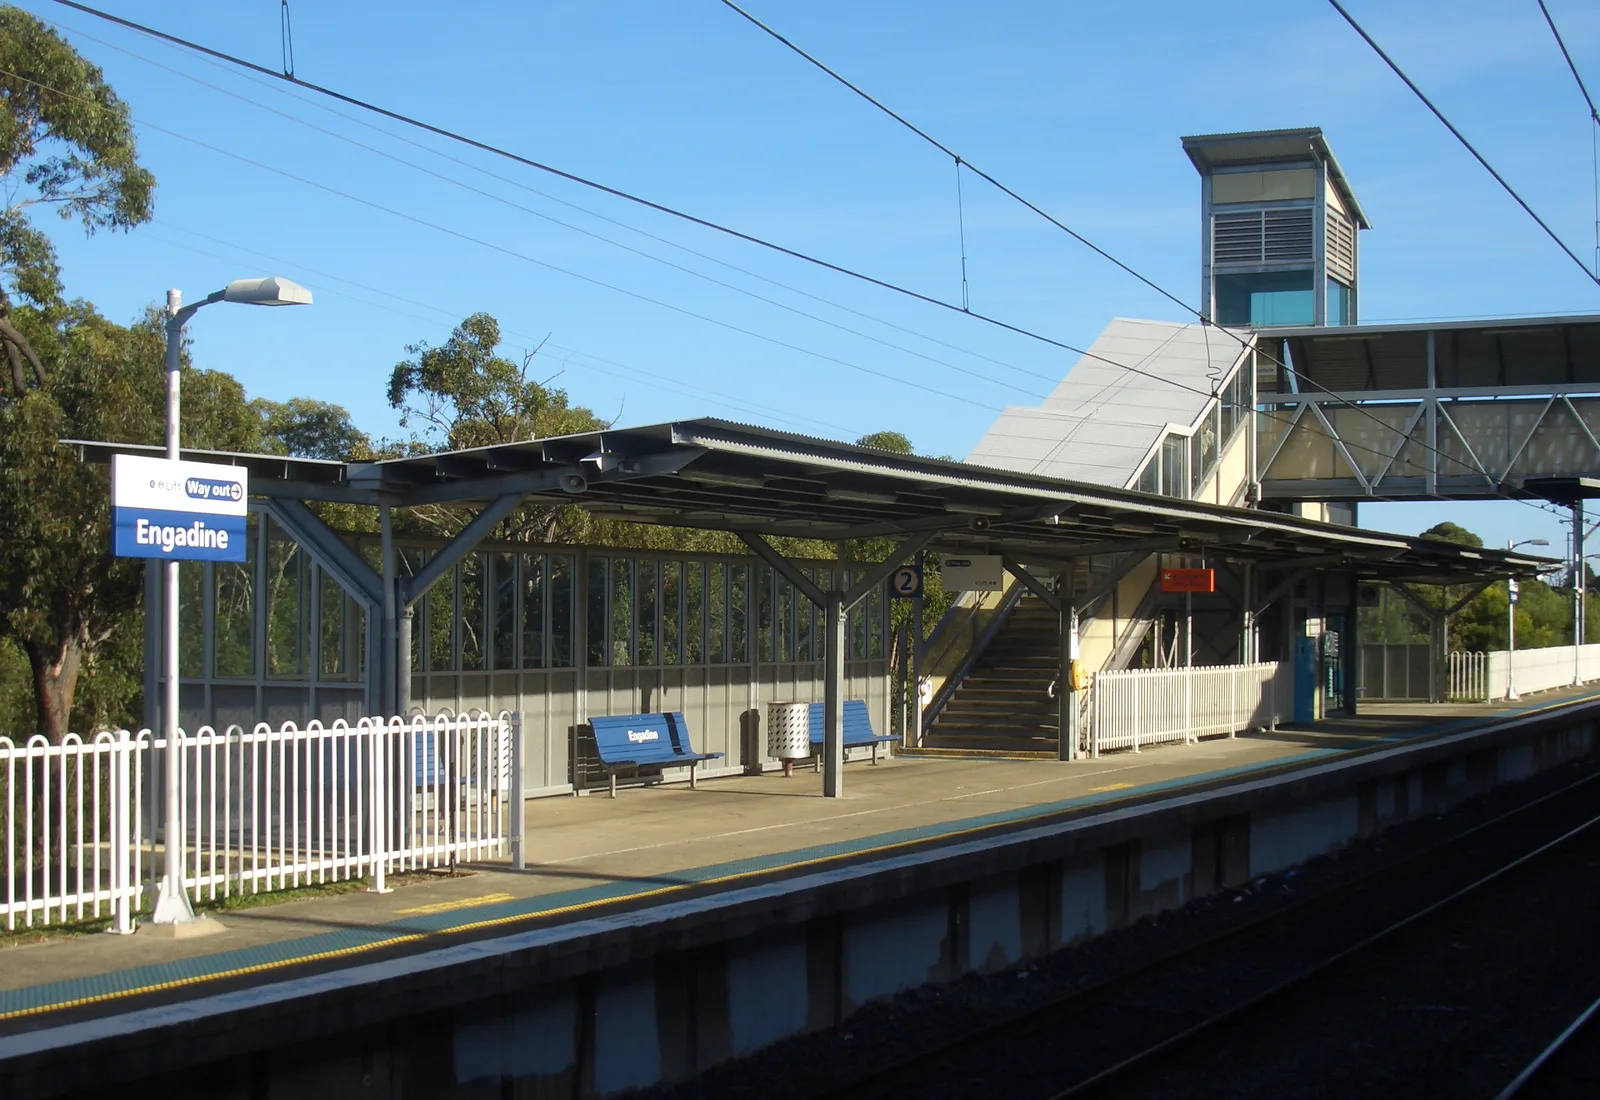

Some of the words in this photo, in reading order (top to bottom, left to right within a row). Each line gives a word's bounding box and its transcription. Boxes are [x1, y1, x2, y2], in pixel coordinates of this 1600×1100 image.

[187, 480, 210, 498] Way
[212, 484, 231, 497] out
[136, 518, 229, 552] Engadine
[900, 571, 913, 591] 2
[627, 729, 659, 743] Engadine
